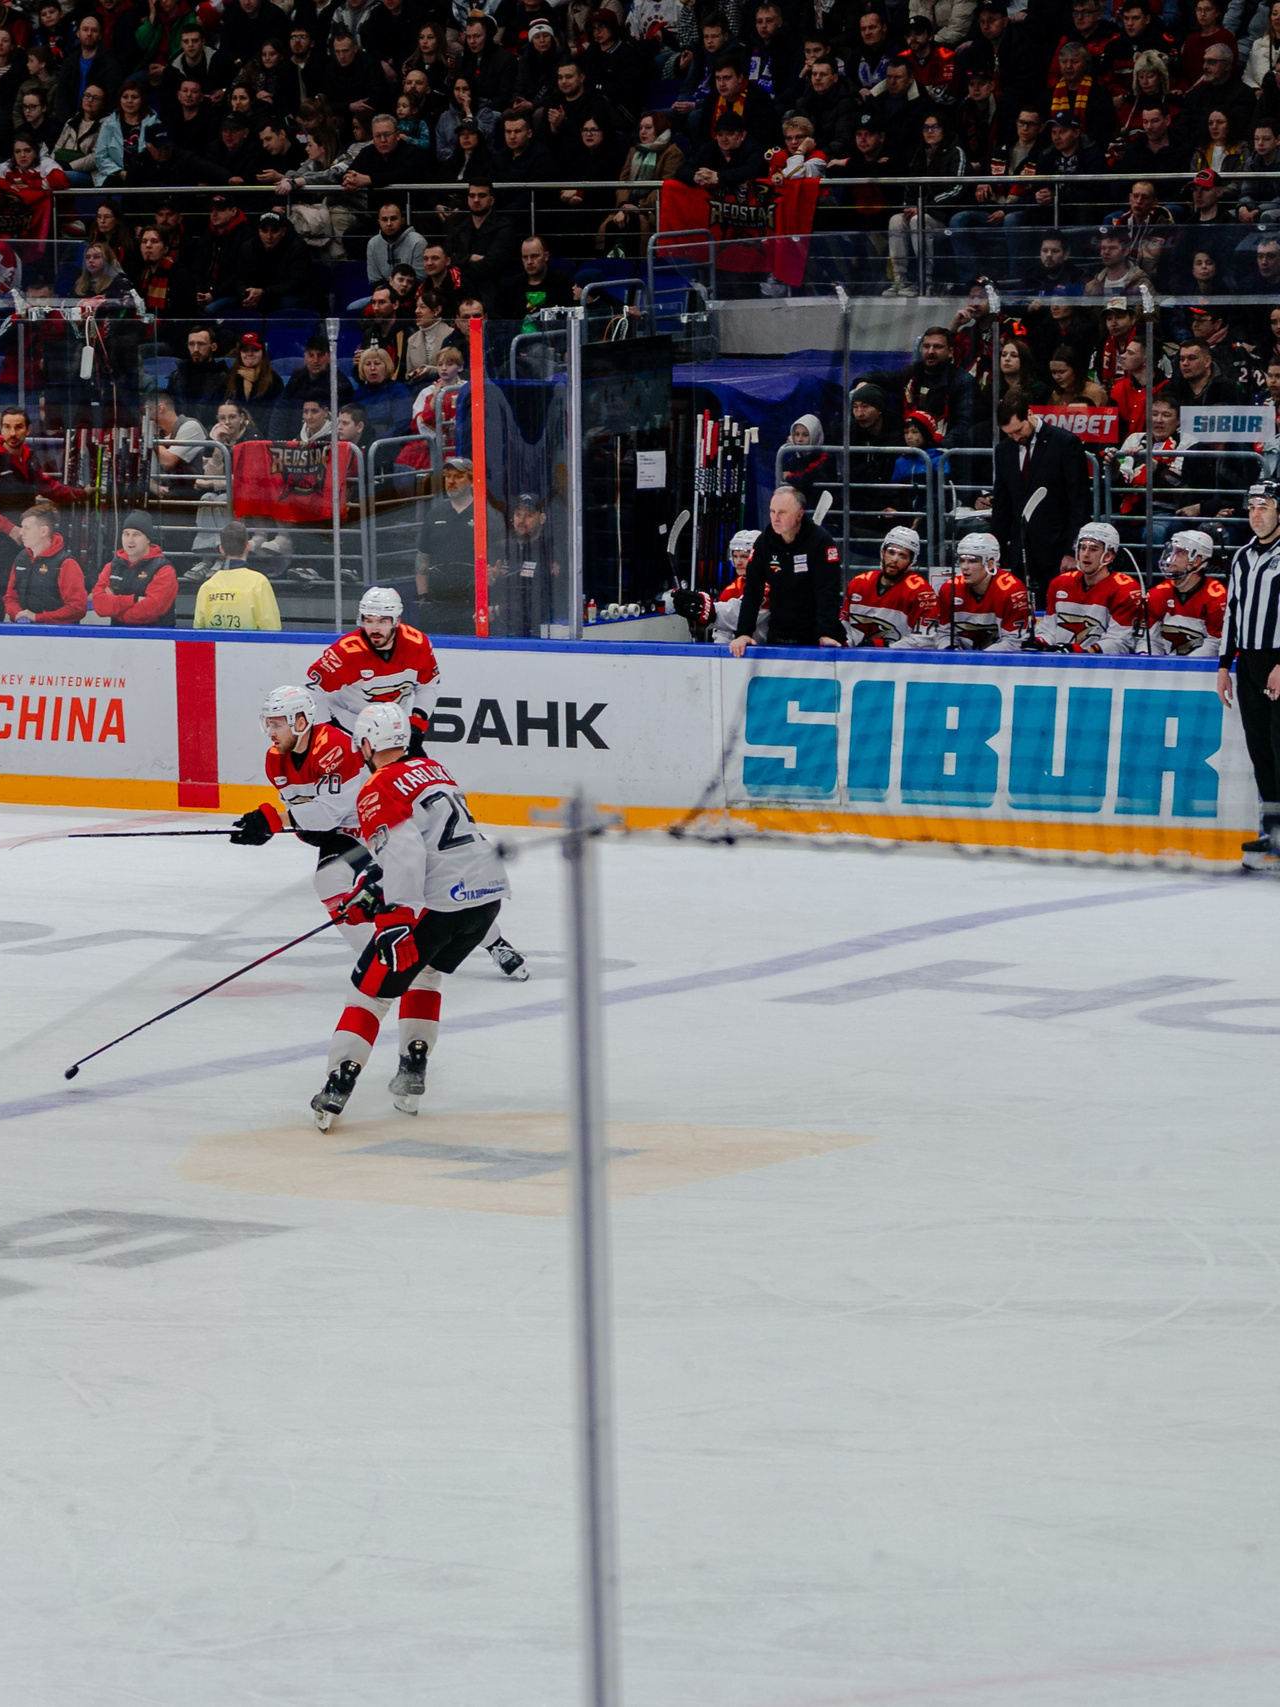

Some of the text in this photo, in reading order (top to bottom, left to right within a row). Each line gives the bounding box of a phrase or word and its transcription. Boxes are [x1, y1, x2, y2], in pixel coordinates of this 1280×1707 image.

[1193, 415, 1263, 433] SIBUR
[208, 592, 236, 602] SAFETY
[29, 675, 127, 688] #UNITEDWEWIN
[423, 697, 610, 749] БАНК
[743, 676, 1224, 818] SIBUR
